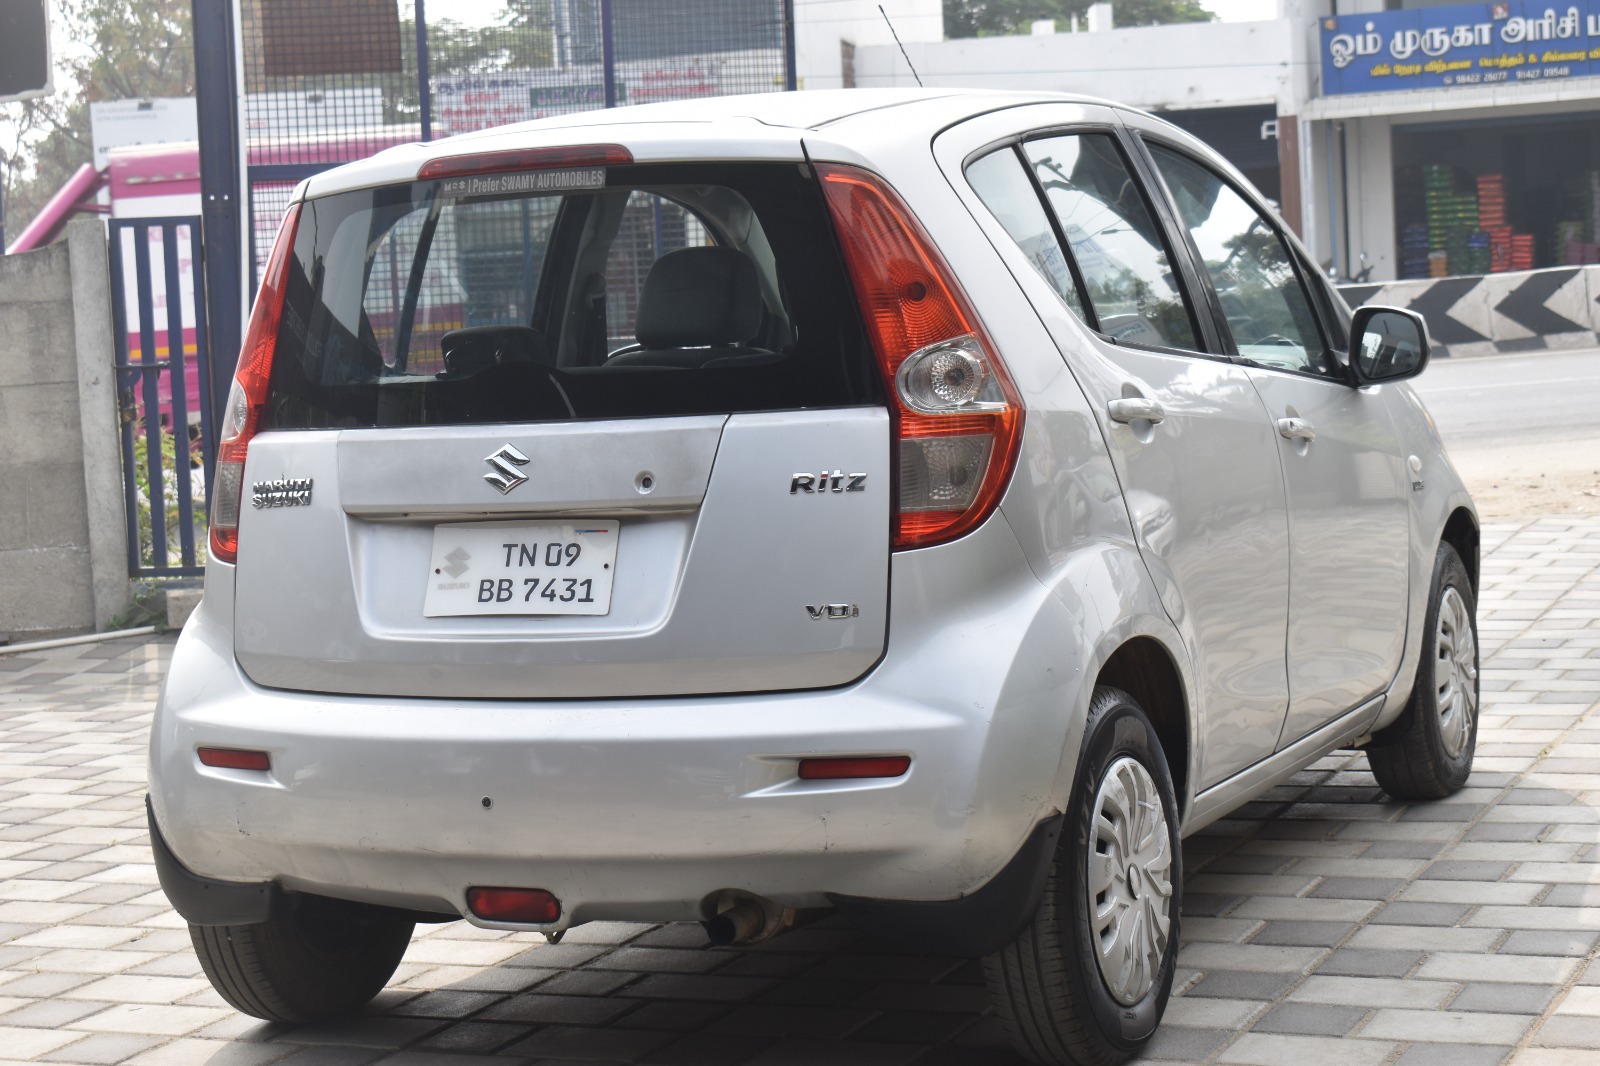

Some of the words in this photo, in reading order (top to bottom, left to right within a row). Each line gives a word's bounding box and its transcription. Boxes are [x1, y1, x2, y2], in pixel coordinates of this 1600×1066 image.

[1330, 21, 1382, 68] ஓம்
[1390, 23, 1492, 59] முருகா
[1501, 6, 1580, 43] அரிசி
[472, 176, 500, 193] Prefer
[501, 173, 536, 190] SWAMY
[538, 170, 604, 188] AUTOMOBILES
[253, 478, 313, 492] MARUTI
[790, 469, 868, 494] Ritz
[252, 490, 311, 509] SUZUKI
[502, 542, 538, 567] TN
[544, 542, 582, 567] 09
[477, 578, 514, 603] BB
[523, 577, 594, 603] 7431
